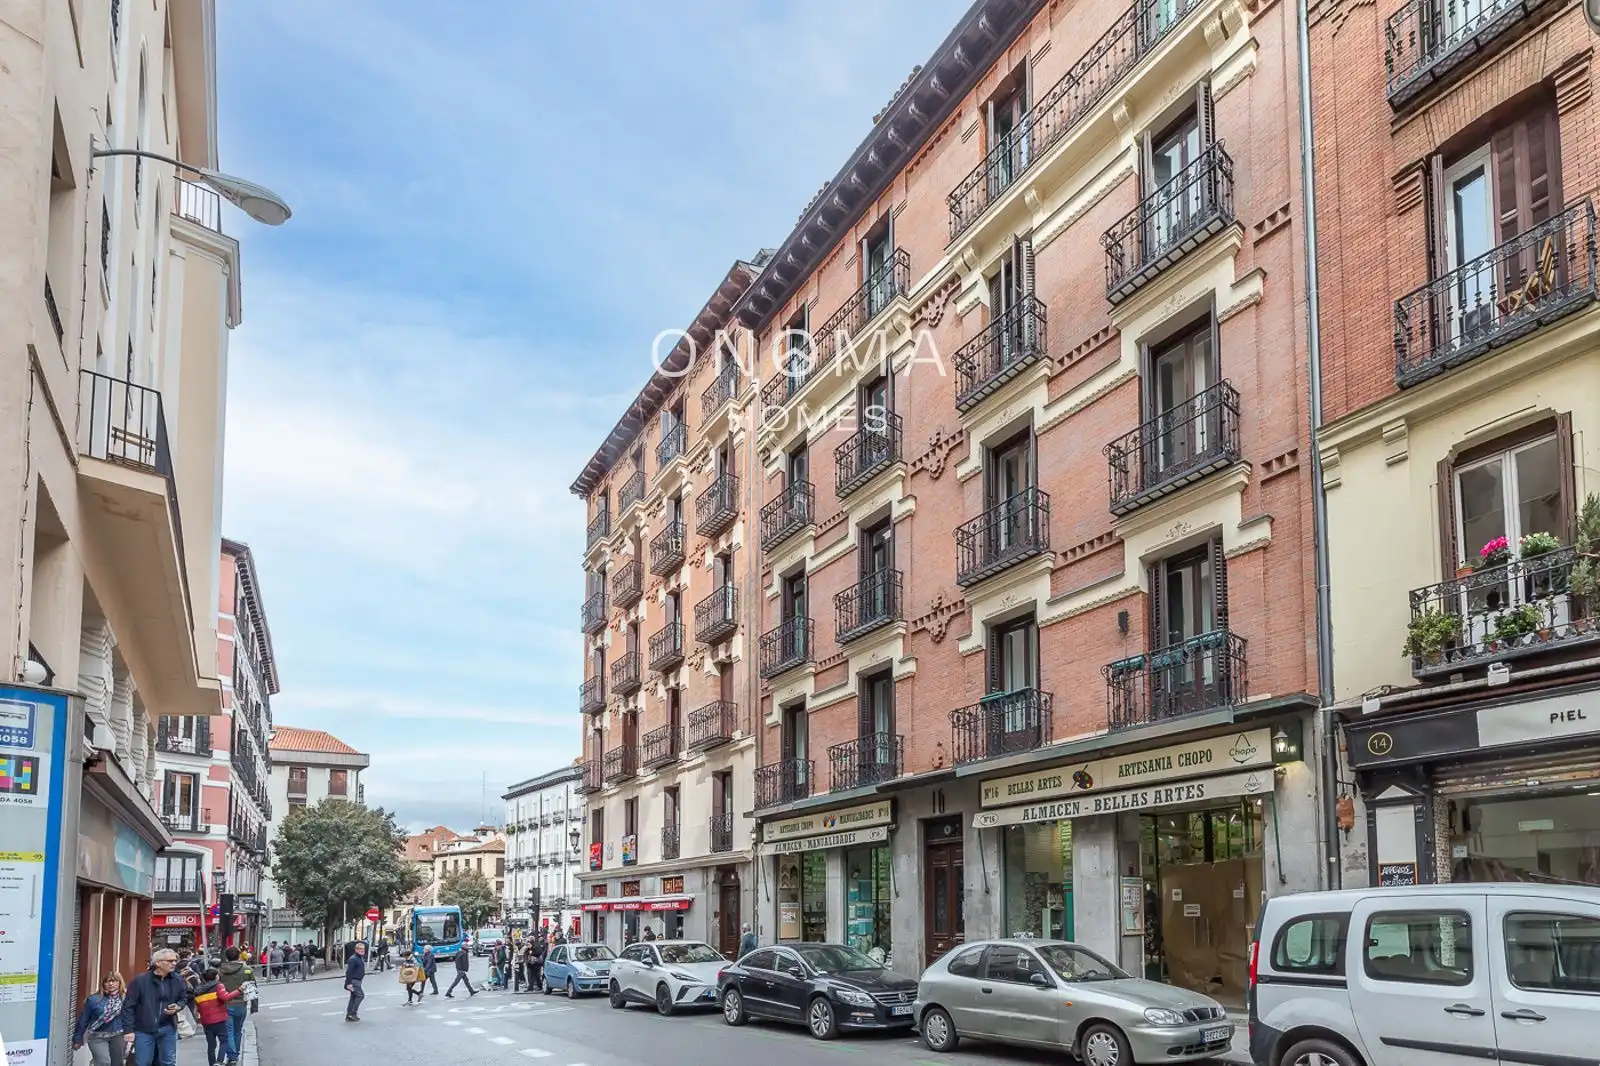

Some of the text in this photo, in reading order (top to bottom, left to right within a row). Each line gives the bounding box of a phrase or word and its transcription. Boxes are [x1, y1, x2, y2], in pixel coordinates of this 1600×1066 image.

[1550, 709, 1587, 724] PIEL
[1228, 745, 1258, 757] Chopo
[1373, 738, 1387, 749] 14
[1118, 748, 1212, 778] ARTESANIA CHOPO
[1007, 780, 1034, 796] BELLAS
[1037, 775, 1062, 790] ARTES
[1022, 801, 1081, 820] ALMACEN
[1094, 791, 1148, 812] BELLAS
[1153, 783, 1205, 805] ARTES
